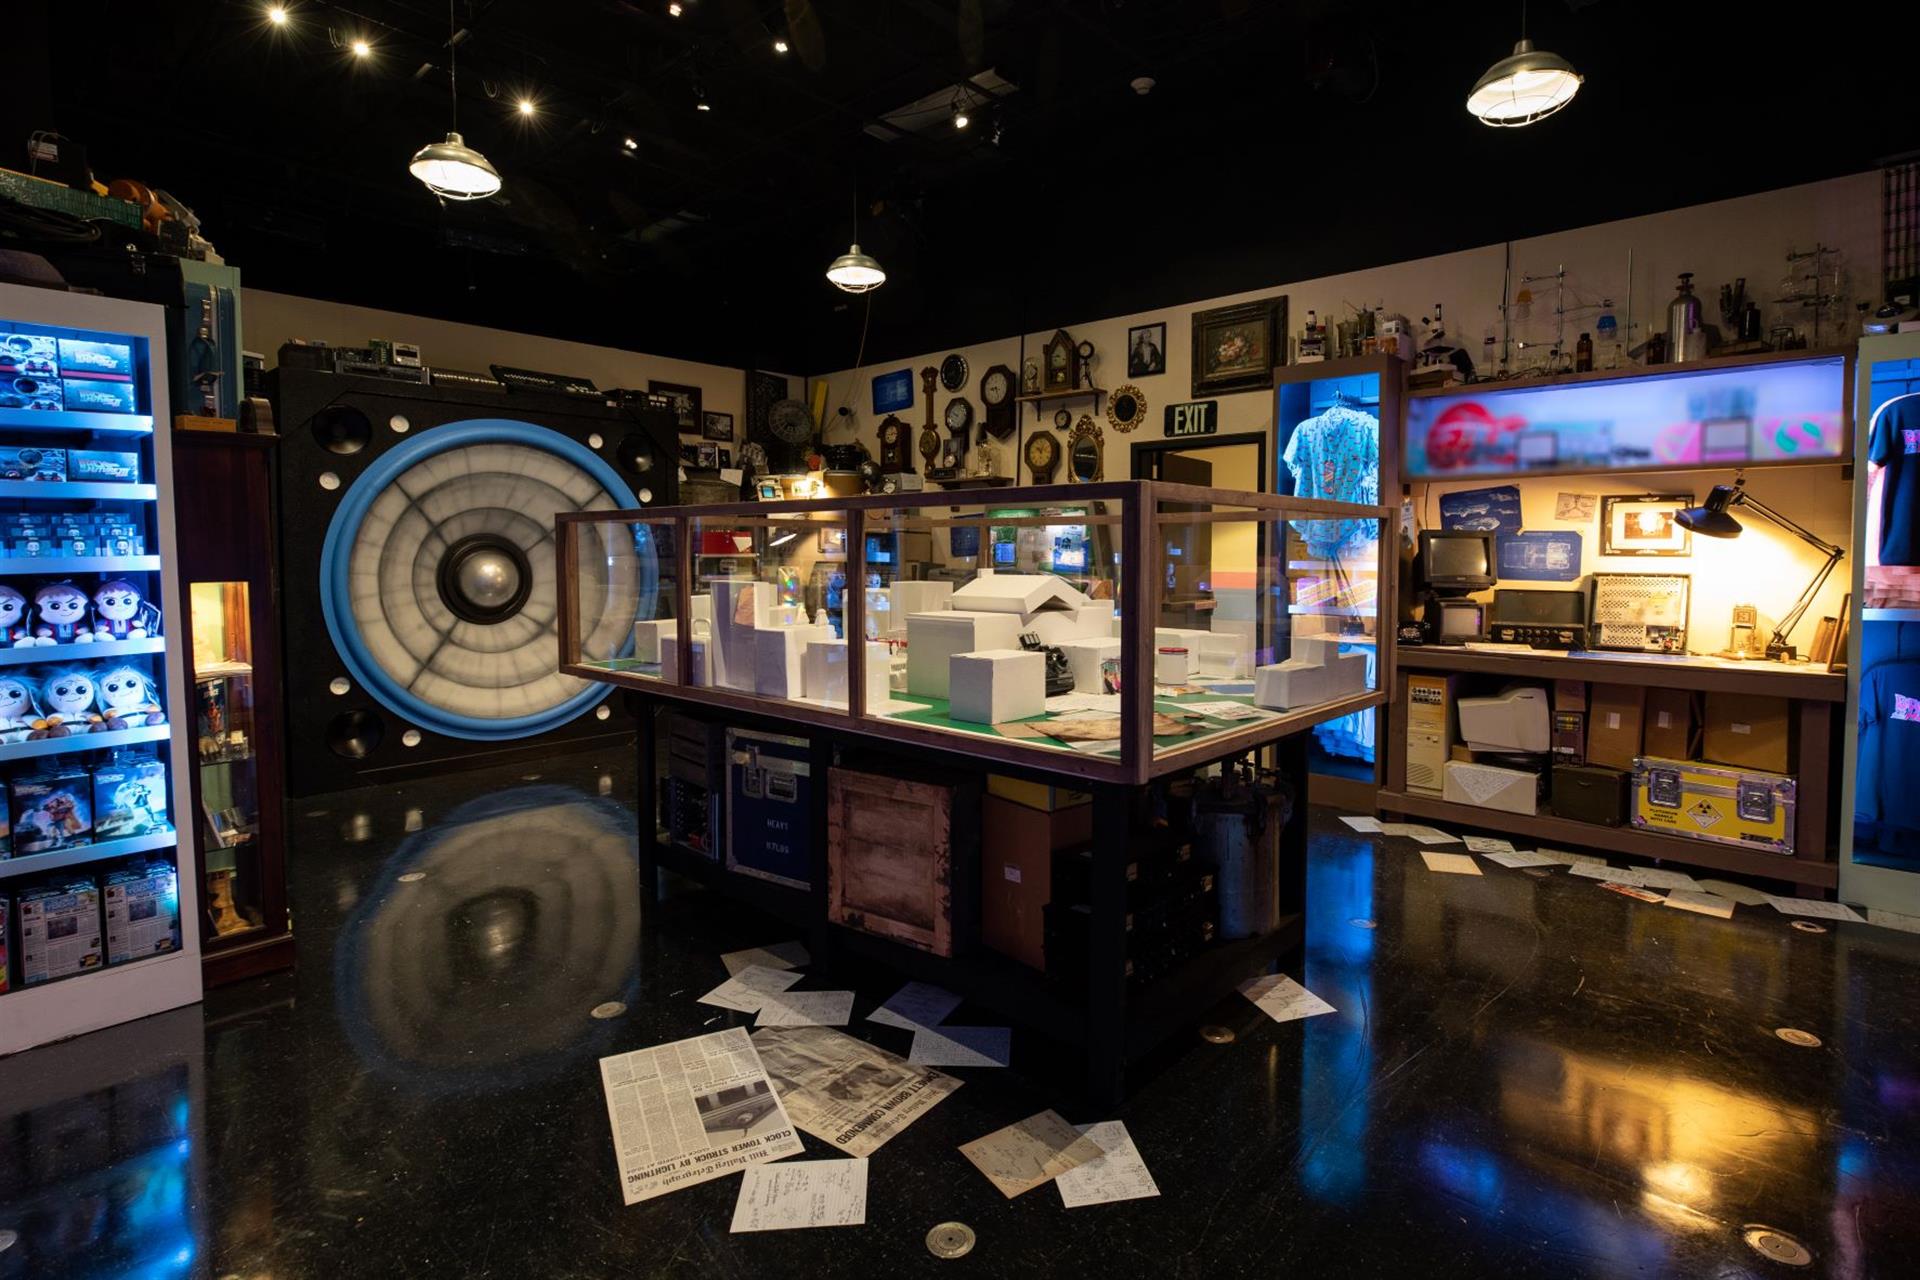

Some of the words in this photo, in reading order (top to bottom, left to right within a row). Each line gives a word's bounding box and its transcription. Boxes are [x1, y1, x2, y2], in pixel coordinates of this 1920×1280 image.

[1174, 403, 1208, 434] EXIT
[881, 1090, 912, 1111] BROWN
[835, 1109, 885, 1145] COMMENDED
[764, 1130, 791, 1143] CLOCK
[731, 1138, 761, 1152] TOWER
[679, 1158, 691, 1168] BY
[693, 1147, 729, 1163] STRUCK
[749, 1150, 768, 1161] Hill
[715, 1156, 746, 1171] Valley
[627, 1163, 676, 1184] LIGHTNING
[662, 1165, 714, 1186] Telegraph
